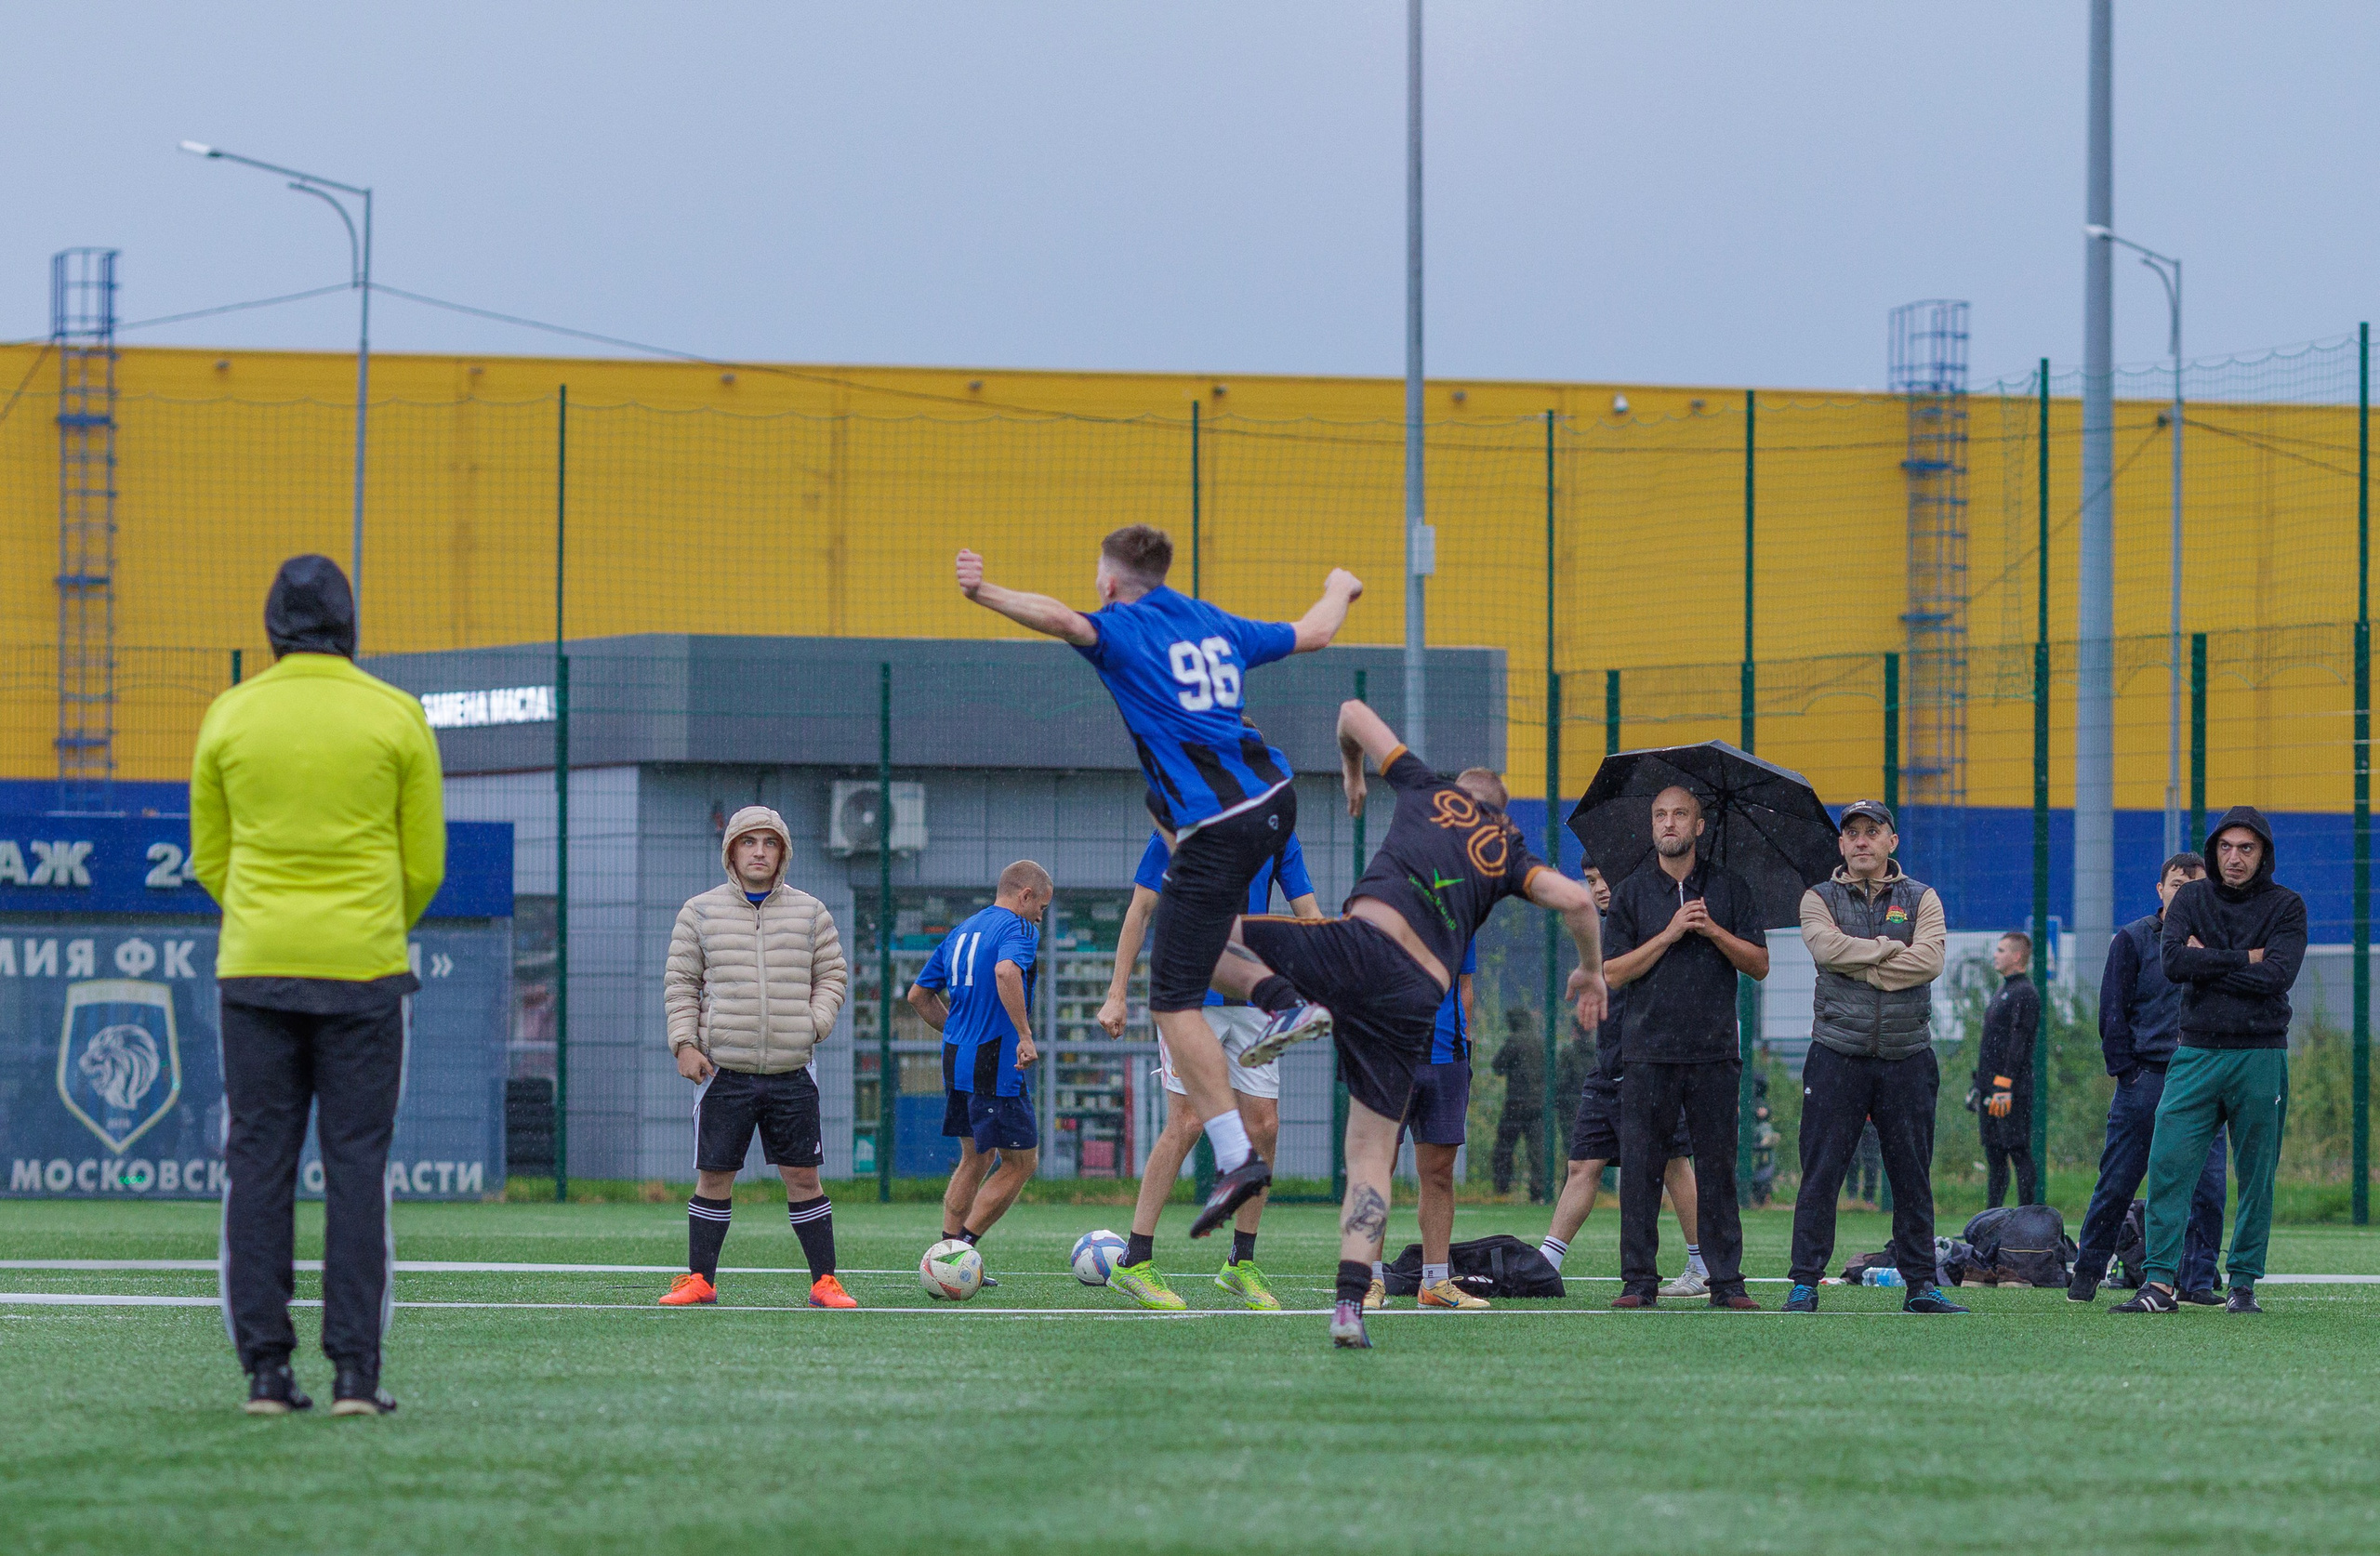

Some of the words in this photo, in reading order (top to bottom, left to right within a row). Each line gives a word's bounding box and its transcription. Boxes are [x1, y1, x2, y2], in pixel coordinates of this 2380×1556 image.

[1169, 636, 1240, 711] 96
[114, 937, 197, 978] ФК
[951, 931, 982, 986] 11
[303, 1159, 483, 1193] ОАСТИ
